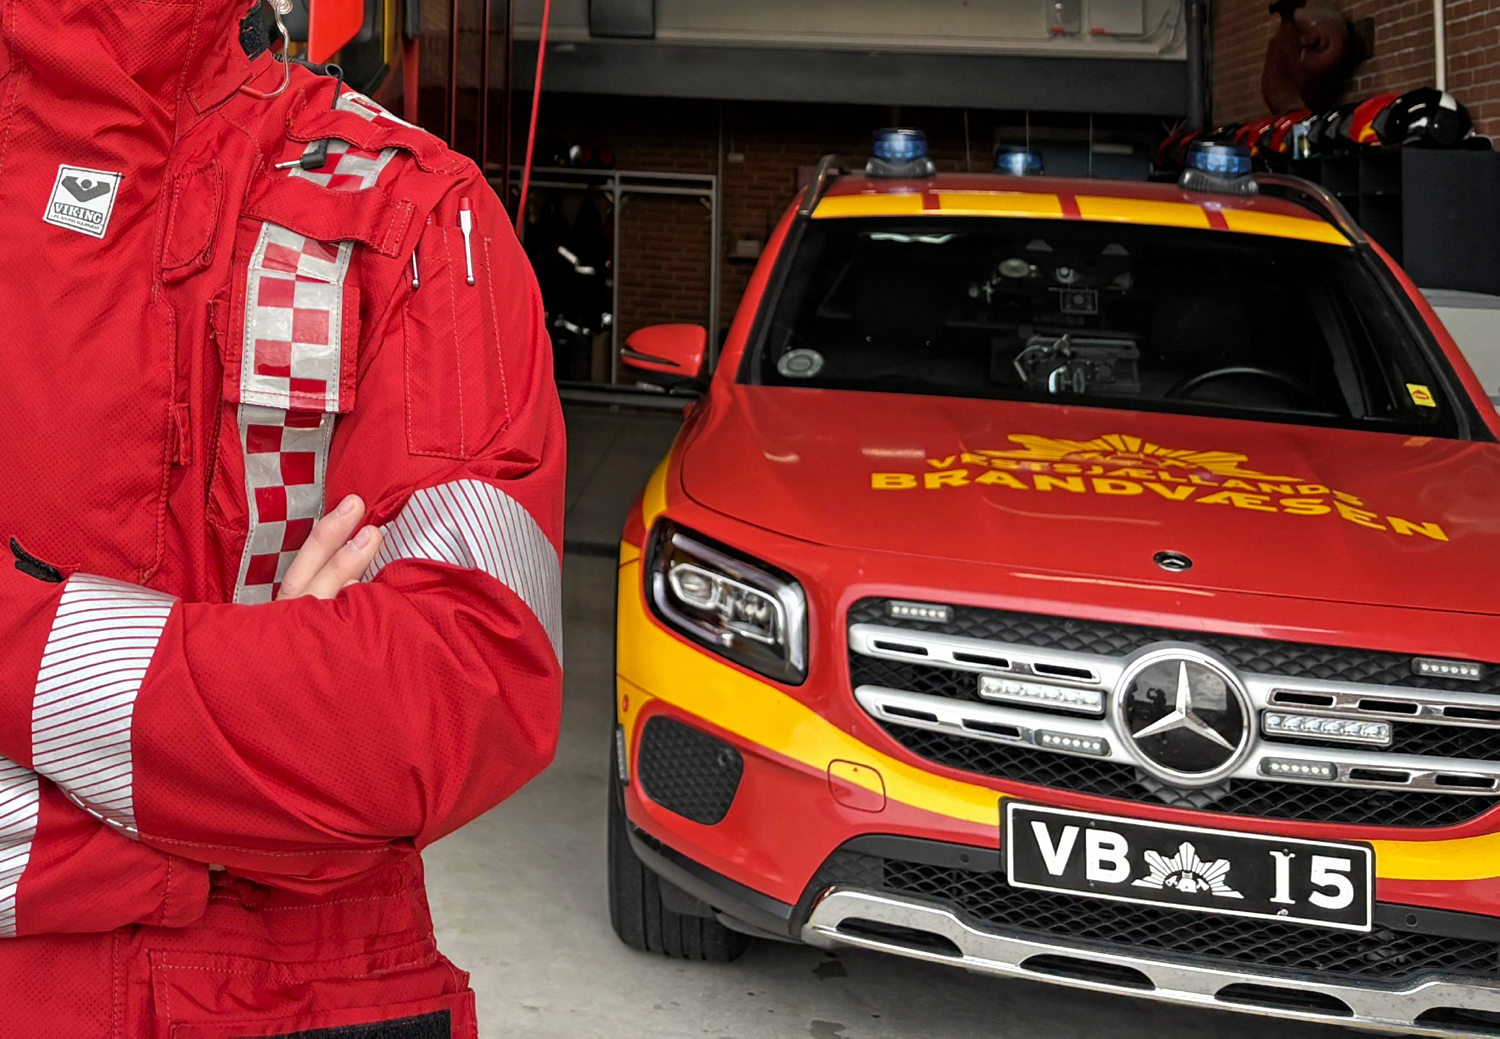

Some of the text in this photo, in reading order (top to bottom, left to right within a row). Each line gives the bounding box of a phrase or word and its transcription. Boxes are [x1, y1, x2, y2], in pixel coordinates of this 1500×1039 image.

[54, 202, 102, 224] VIKING
[871, 469, 1449, 542] BRANDVÆSEN
[1030, 820, 1131, 884] VB
